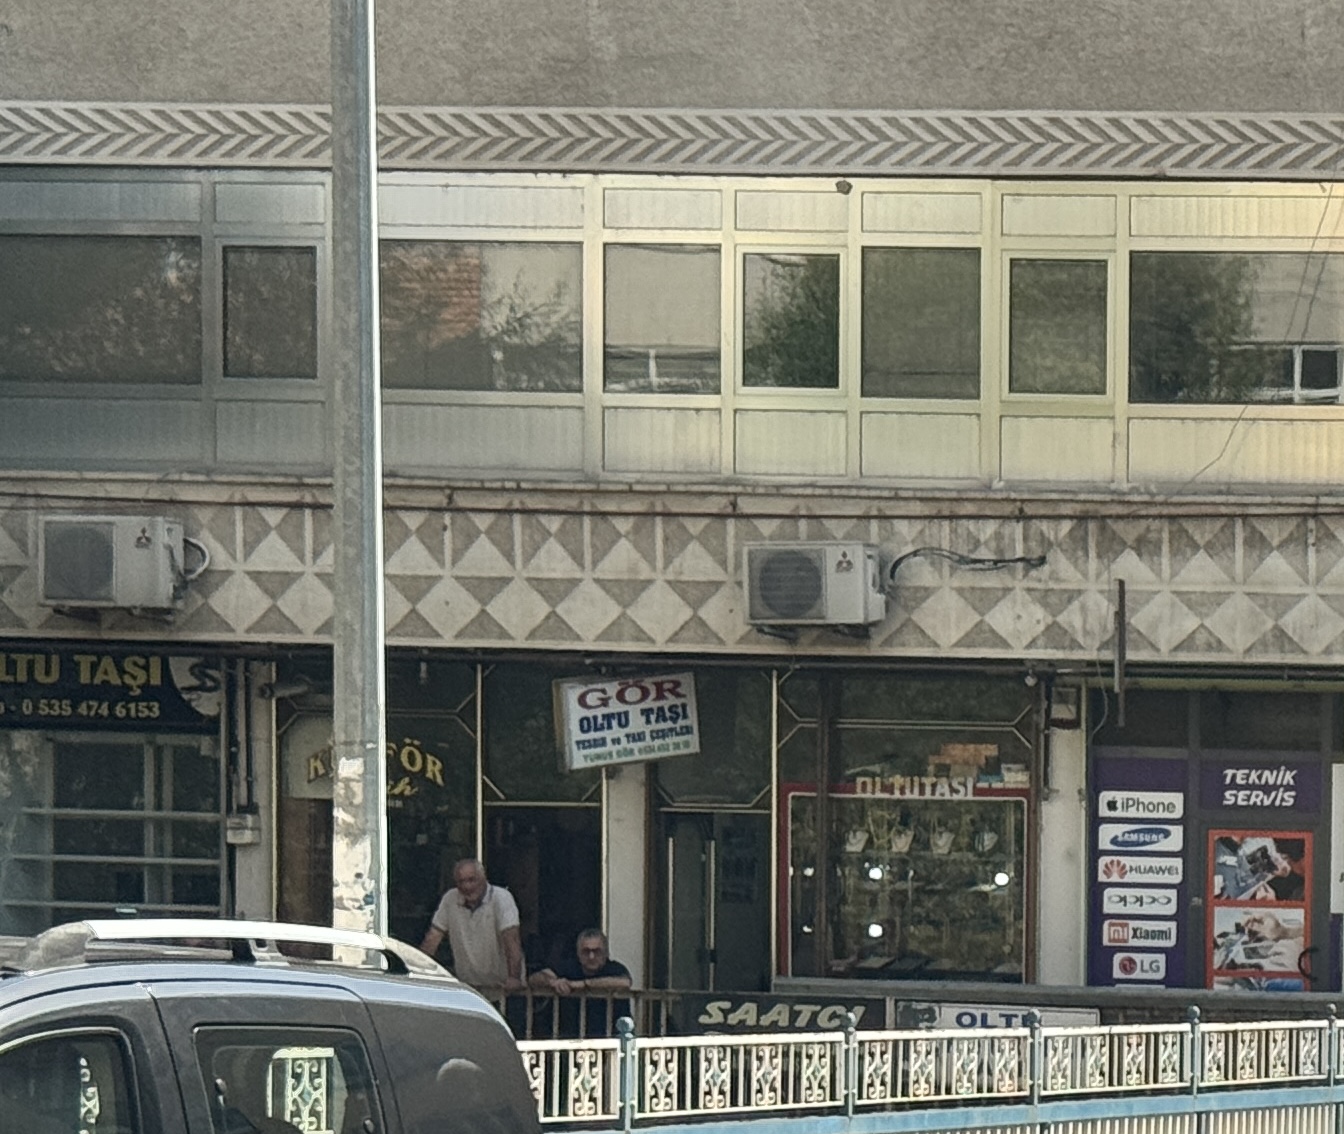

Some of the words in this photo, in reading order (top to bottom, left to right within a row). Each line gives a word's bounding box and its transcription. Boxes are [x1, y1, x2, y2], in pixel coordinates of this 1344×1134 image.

[0, 653, 60, 684] LTU
[73, 655, 162, 696] TAŞI
[577, 679, 688, 710] GÖR
[38, 700, 72, 717] 535
[78, 701, 110, 718] 474
[115, 702, 160, 719] 6153
[579, 710, 630, 734] OLTU
[640, 703, 689, 726] TAŞI
[1223, 766, 1298, 786] TEKNİK
[1121, 797, 1177, 814] iPhone
[1222, 788, 1298, 808] SERVİS
[1117, 832, 1166, 843] SAMSUNG
[1129, 864, 1180, 876] HUAWEI
[1131, 927, 1172, 942] Xiaomi
[1140, 960, 1161, 974] LG
